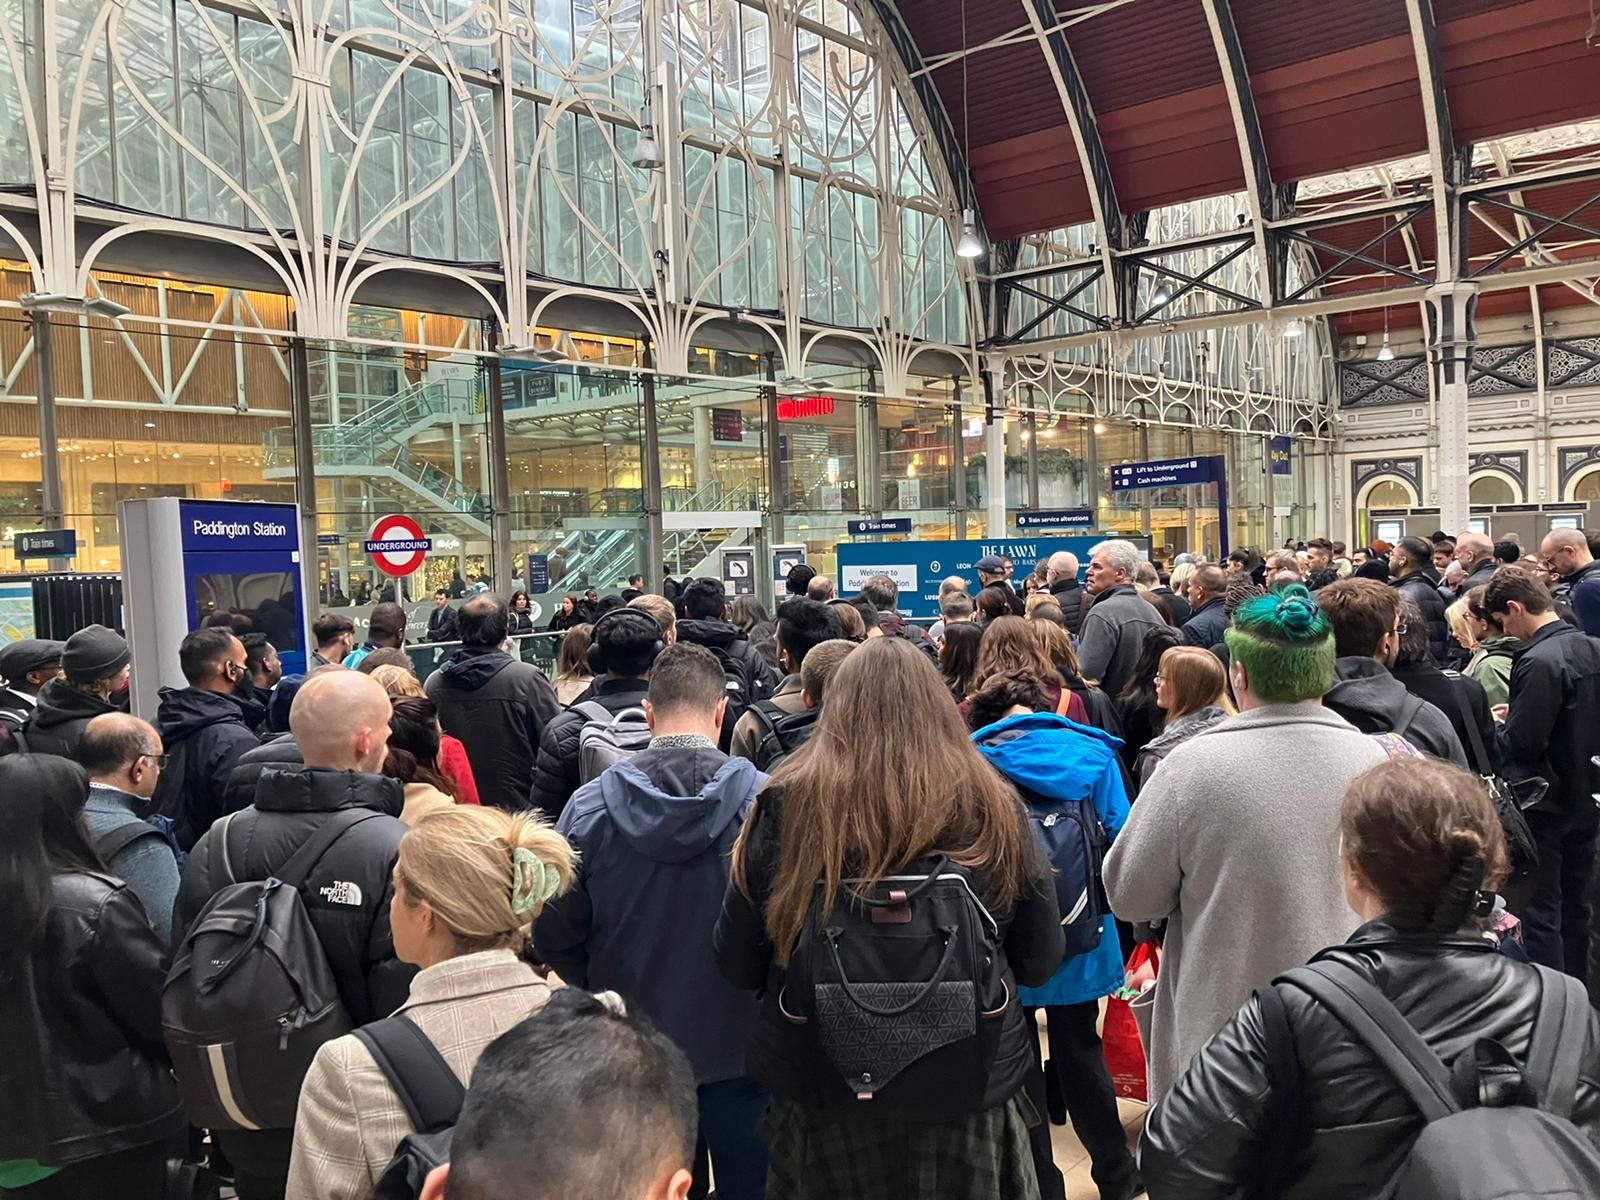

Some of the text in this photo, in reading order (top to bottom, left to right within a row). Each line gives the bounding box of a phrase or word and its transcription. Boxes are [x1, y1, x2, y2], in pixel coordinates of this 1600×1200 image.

[1136, 466, 1146, 474] Lift
[1154, 462, 1190, 472] Underground
[193, 520, 286, 539] Paddington Station
[868, 522, 880, 530] Train
[367, 541, 429, 551] UNDERGROUND
[860, 569, 898, 577] Welcome to
[333, 881, 350, 889] THE
[320, 887, 348, 896] NORTH
[328, 895, 349, 904] FACE
